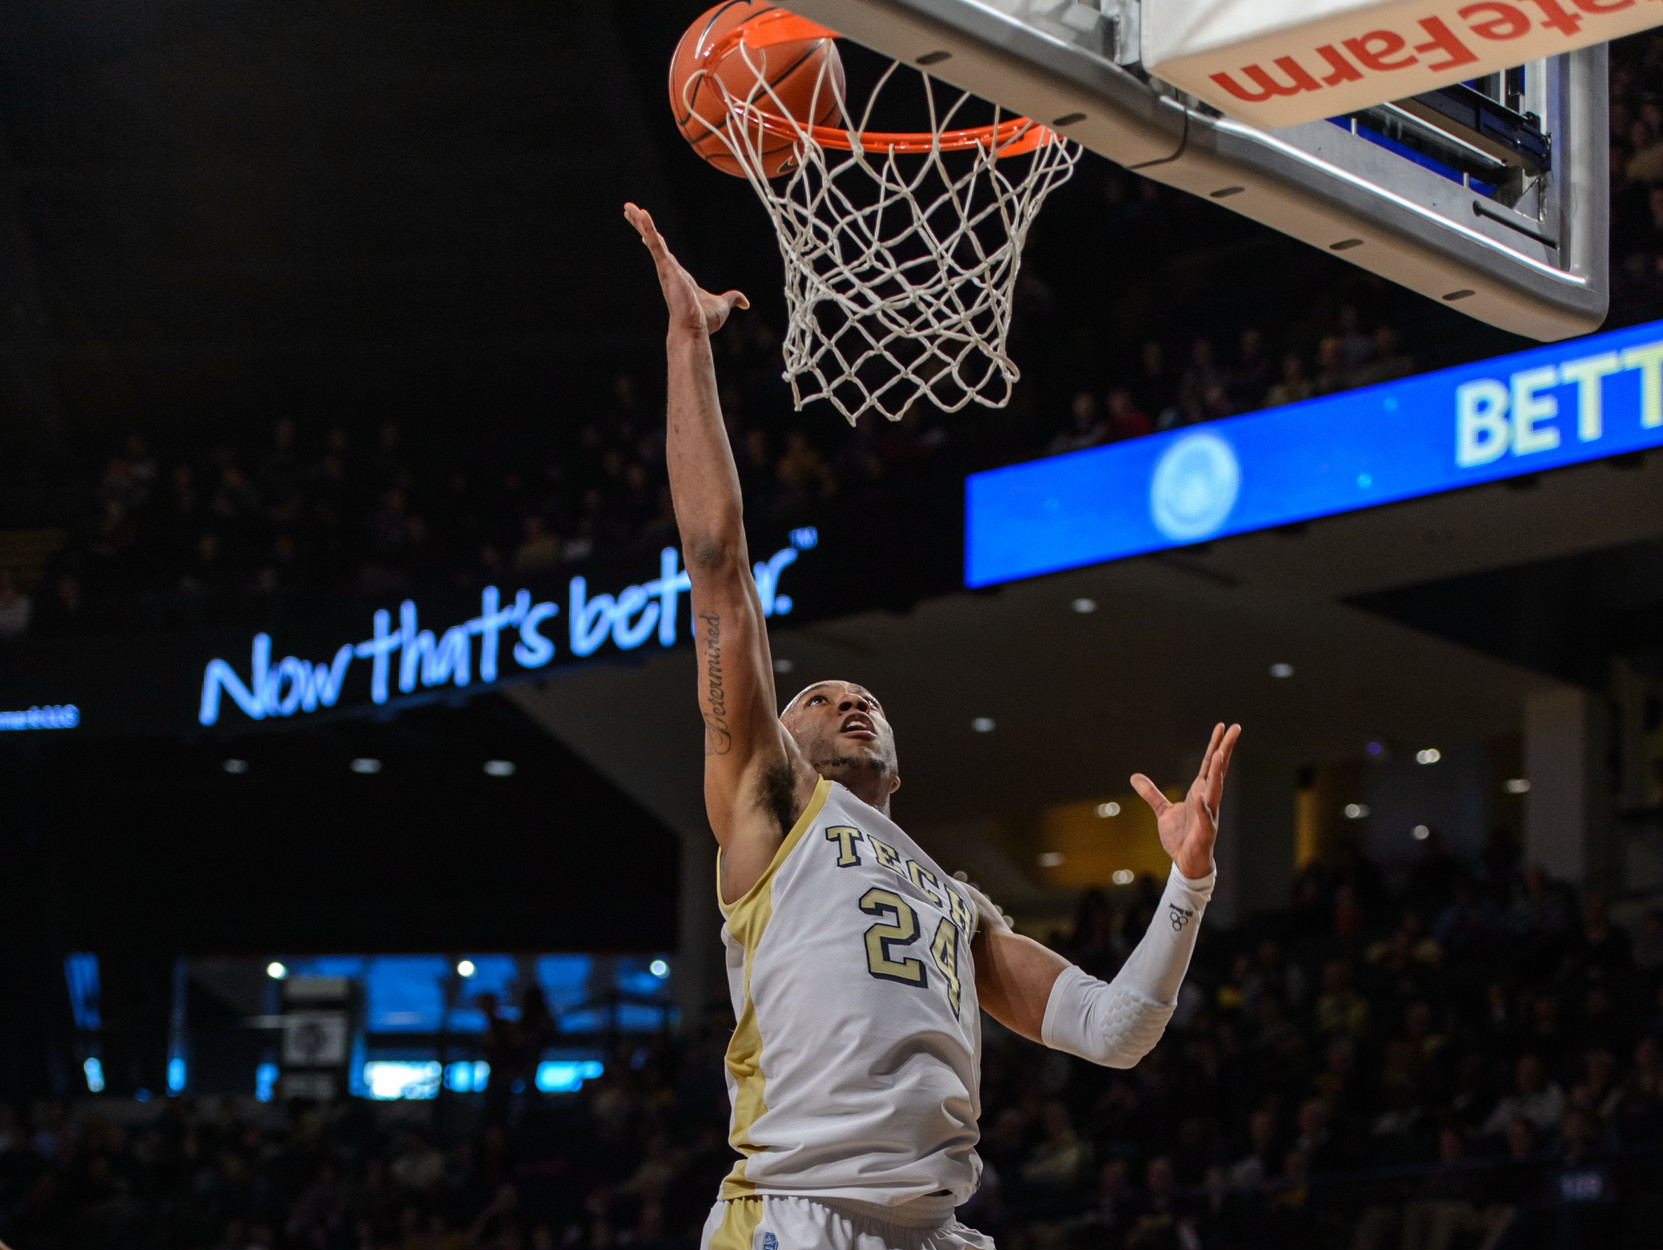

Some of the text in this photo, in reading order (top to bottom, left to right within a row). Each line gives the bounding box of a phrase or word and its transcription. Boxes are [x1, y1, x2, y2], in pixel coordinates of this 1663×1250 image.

[199, 545, 798, 727] Now that's betr.
[825, 825, 974, 944] TECH
[858, 887, 962, 1022] 24
